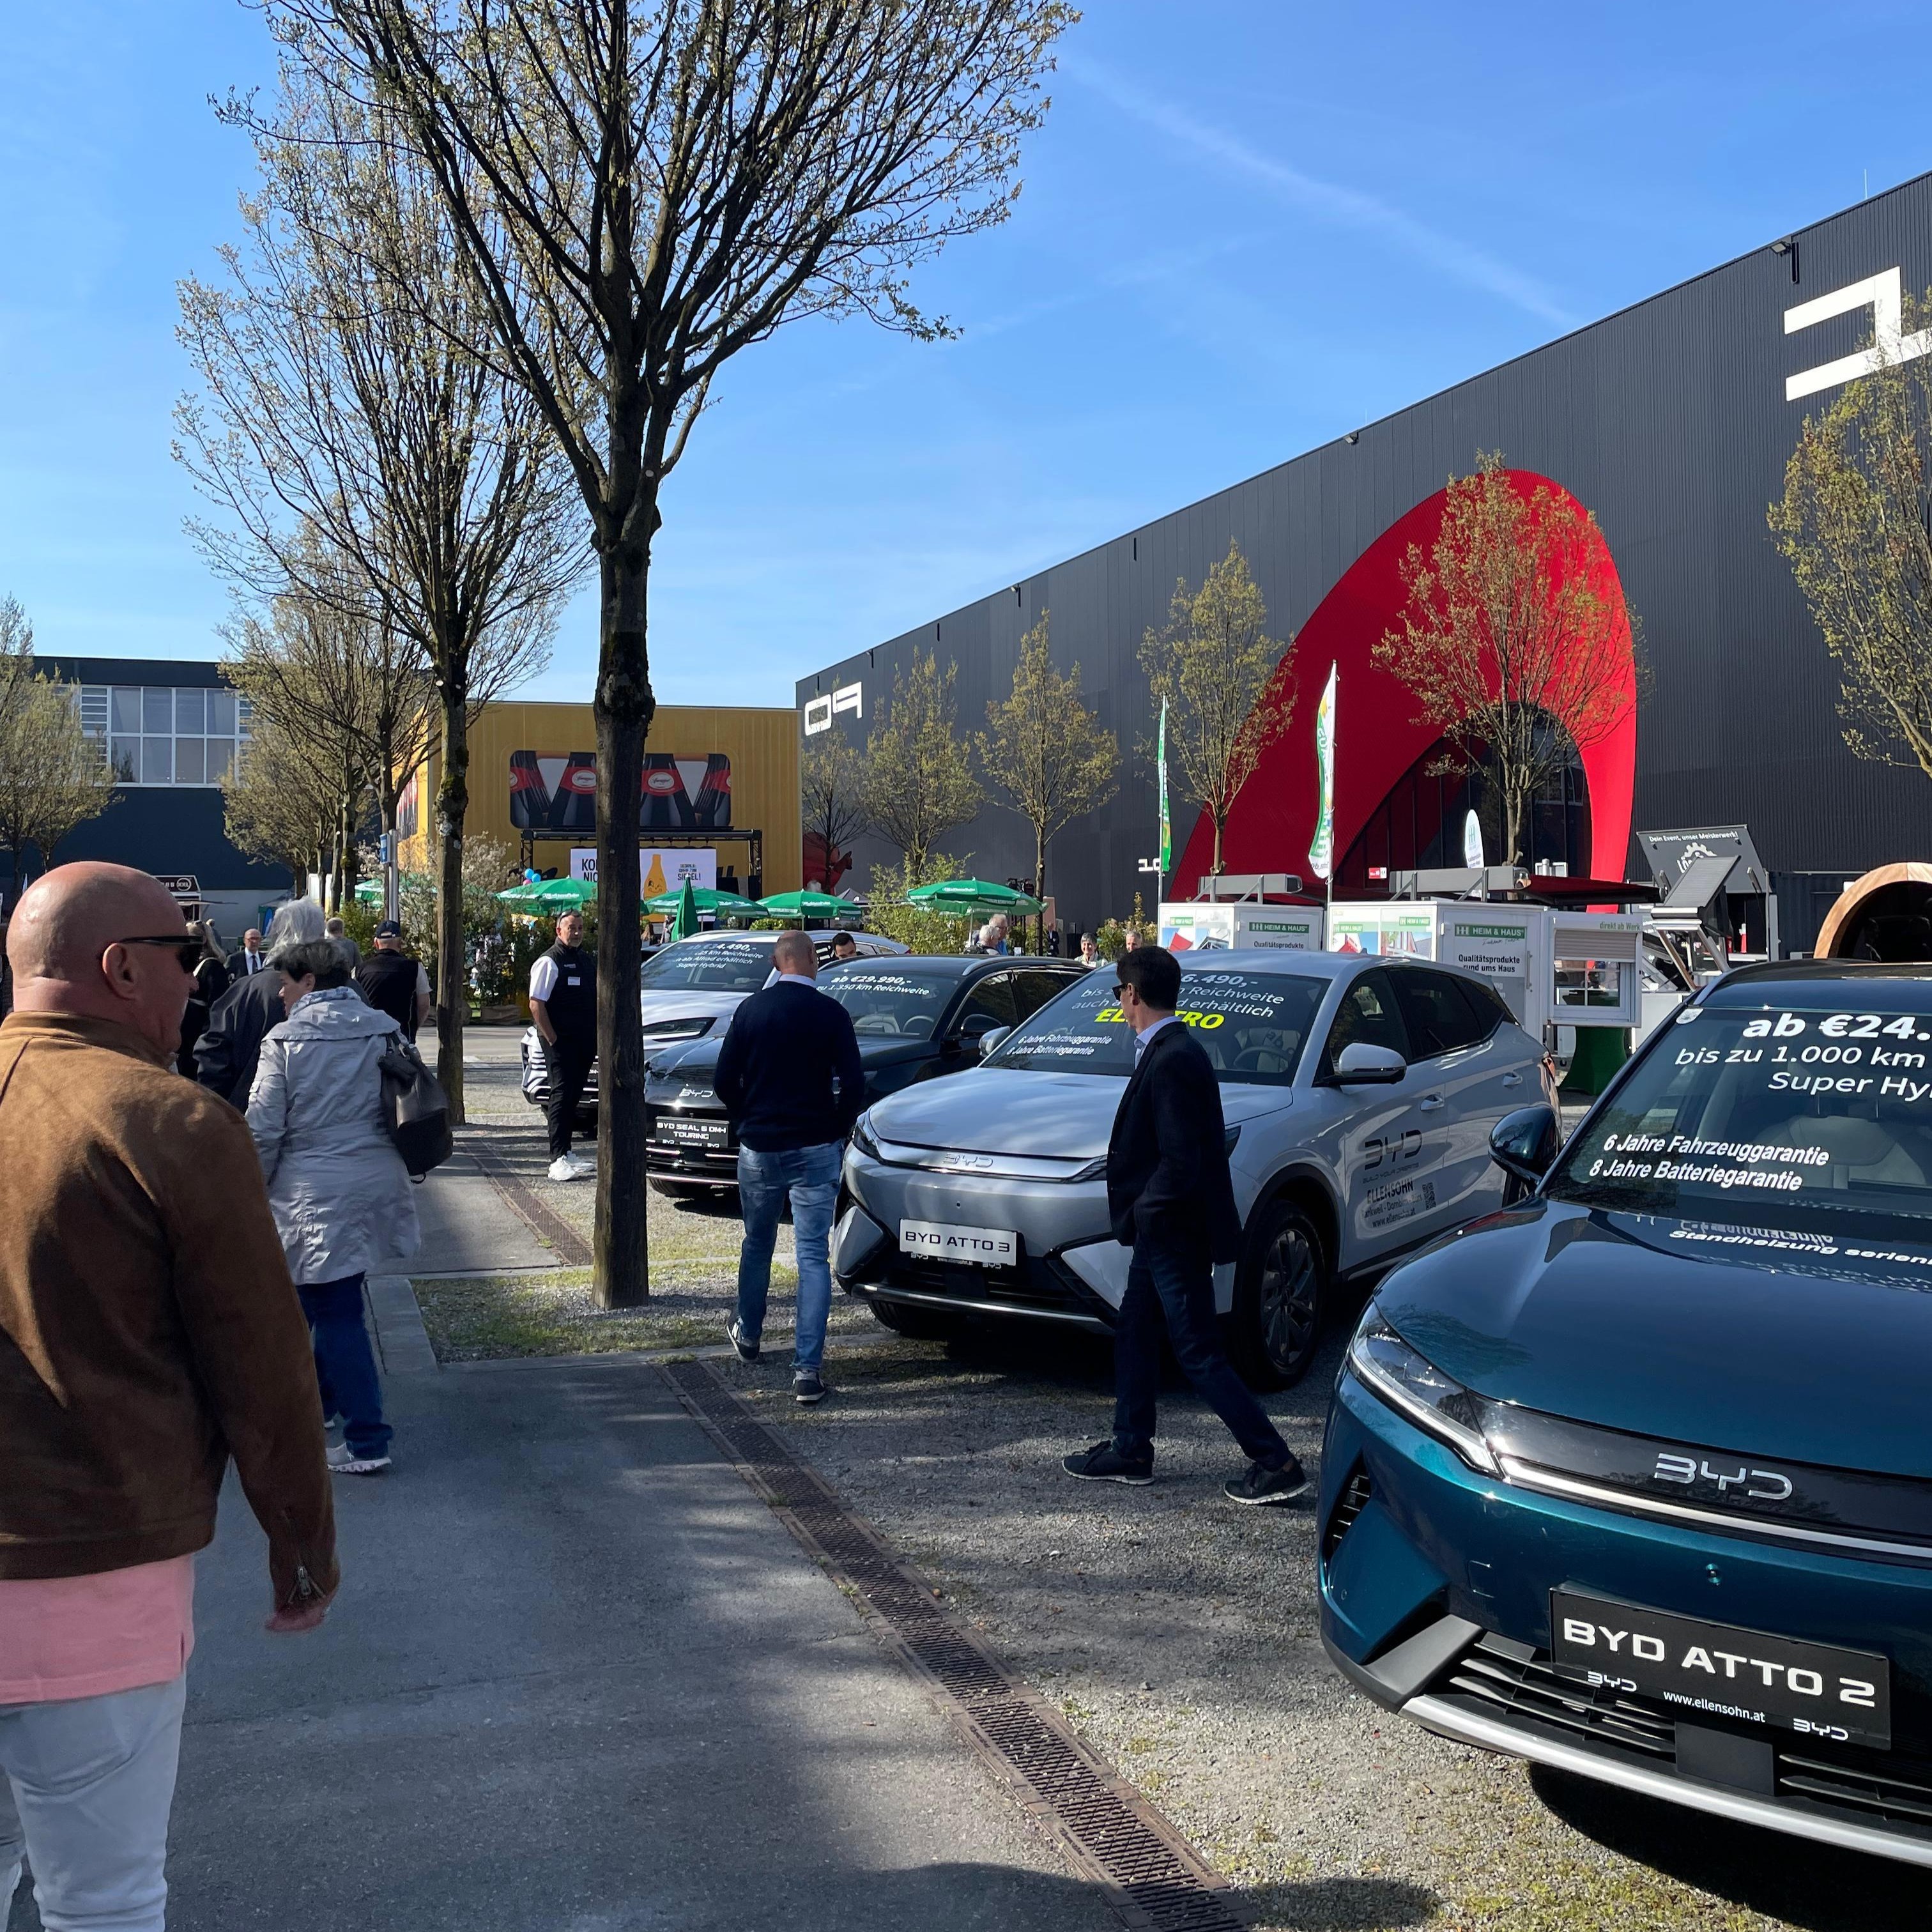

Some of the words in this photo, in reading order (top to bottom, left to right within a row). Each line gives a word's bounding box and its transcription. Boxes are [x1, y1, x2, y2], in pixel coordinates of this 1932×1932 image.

[805, 682, 862, 736] 09
[1699, 831, 1738, 839] Meisterwerk!
[582, 859, 598, 871] KO
[721, 951, 763, 959] Reichweite
[1459, 954, 1520, 964] Qualitätsprodukte
[850, 976, 912, 985] €29.990,-
[873, 985, 930, 995] Reichweite
[1181, 974, 1259, 988] 6.490,-
[1081, 988, 1104, 997] bis
[1188, 987, 1284, 1004] Reichweite
[1071, 999, 1108, 1009] auch
[1190, 1000, 1273, 1017] erhältlich
[1094, 1008, 1225, 1029] ELTRO
[1743, 1013, 1805, 1038] ab
[1012, 1046, 1034, 1054] Jahre
[1033, 1045, 1094, 1055] Batteriegarantie
[1024, 1035, 1045, 1043] Jahre
[1045, 1034, 1112, 1045] Fahrzeuggarantie
[1675, 1046, 1720, 1065] bis
[1725, 1049, 1763, 1062] zu
[1771, 1046, 1862, 1064] 1.000
[1870, 1046, 1926, 1068] km
[679, 1088, 714, 1098] BYD
[1768, 1072, 1873, 1095] Super
[1880, 1076, 1932, 1101] Hy
[673, 1131, 710, 1140] TOURING
[1365, 1130, 1422, 1170] BYD
[1604, 1134, 1617, 1151] 6
[1616, 1135, 1665, 1152] Jahre
[1667, 1135, 1830, 1166] Fahrzeuggarantie
[942, 1154, 993, 1168] BYD
[1589, 1159, 1603, 1176] 8
[1602, 1160, 1652, 1177] Jahre
[1653, 1161, 1802, 1191] Batteriegarantie
[1367, 1177, 1414, 1204] ELLENSOHN
[905, 1231, 941, 1245] BYD
[946, 1236, 994, 1251] ATTO
[998, 1242, 1010, 1252] 3
[1669, 1230, 1839, 1255] Standheizung
[1844, 1249, 1932, 1265] serien
[1654, 1453, 1793, 1499] BYD
[1563, 1618, 1665, 1662] BYD
[1681, 1646, 1823, 1696] ATTO
[1839, 1677, 1875, 1708] 2
[1587, 1671, 1637, 1692] BYD
[1663, 1691, 1765, 1723] www.ellensohn.at
[1793, 1718, 1849, 1741] BYD
